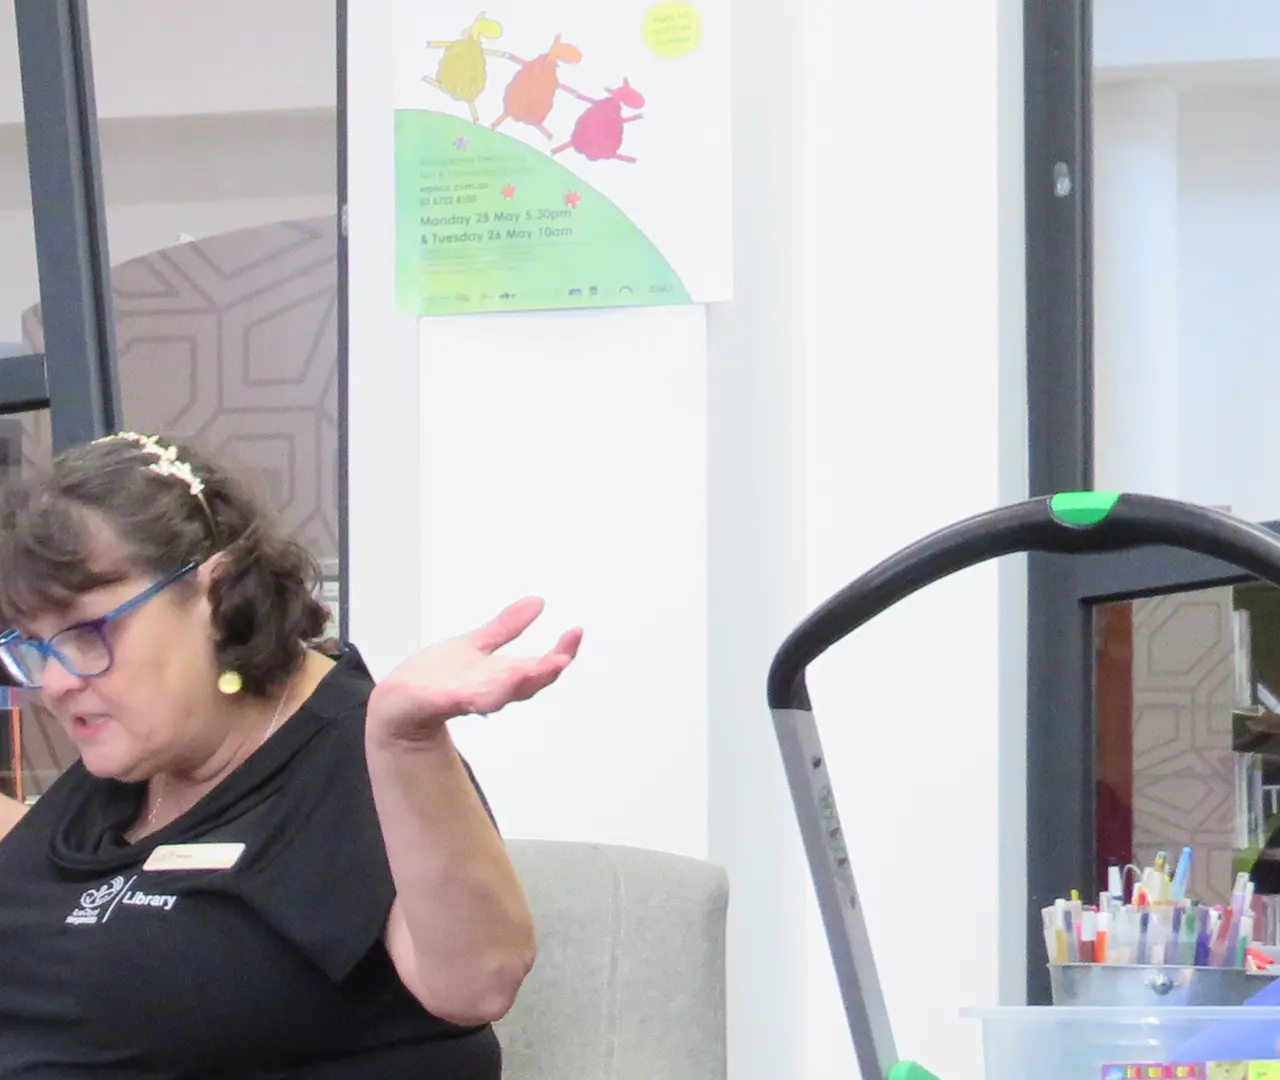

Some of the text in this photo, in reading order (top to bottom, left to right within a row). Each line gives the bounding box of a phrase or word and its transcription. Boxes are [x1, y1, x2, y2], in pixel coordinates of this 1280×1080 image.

[420, 213, 471, 227] Monday
[493, 210, 521, 225] May
[432, 230, 484, 245] Tuesday
[487, 228, 502, 241] 26
[505, 227, 533, 241] May
[538, 225, 573, 239] 10am
[122, 890, 178, 911] Library
